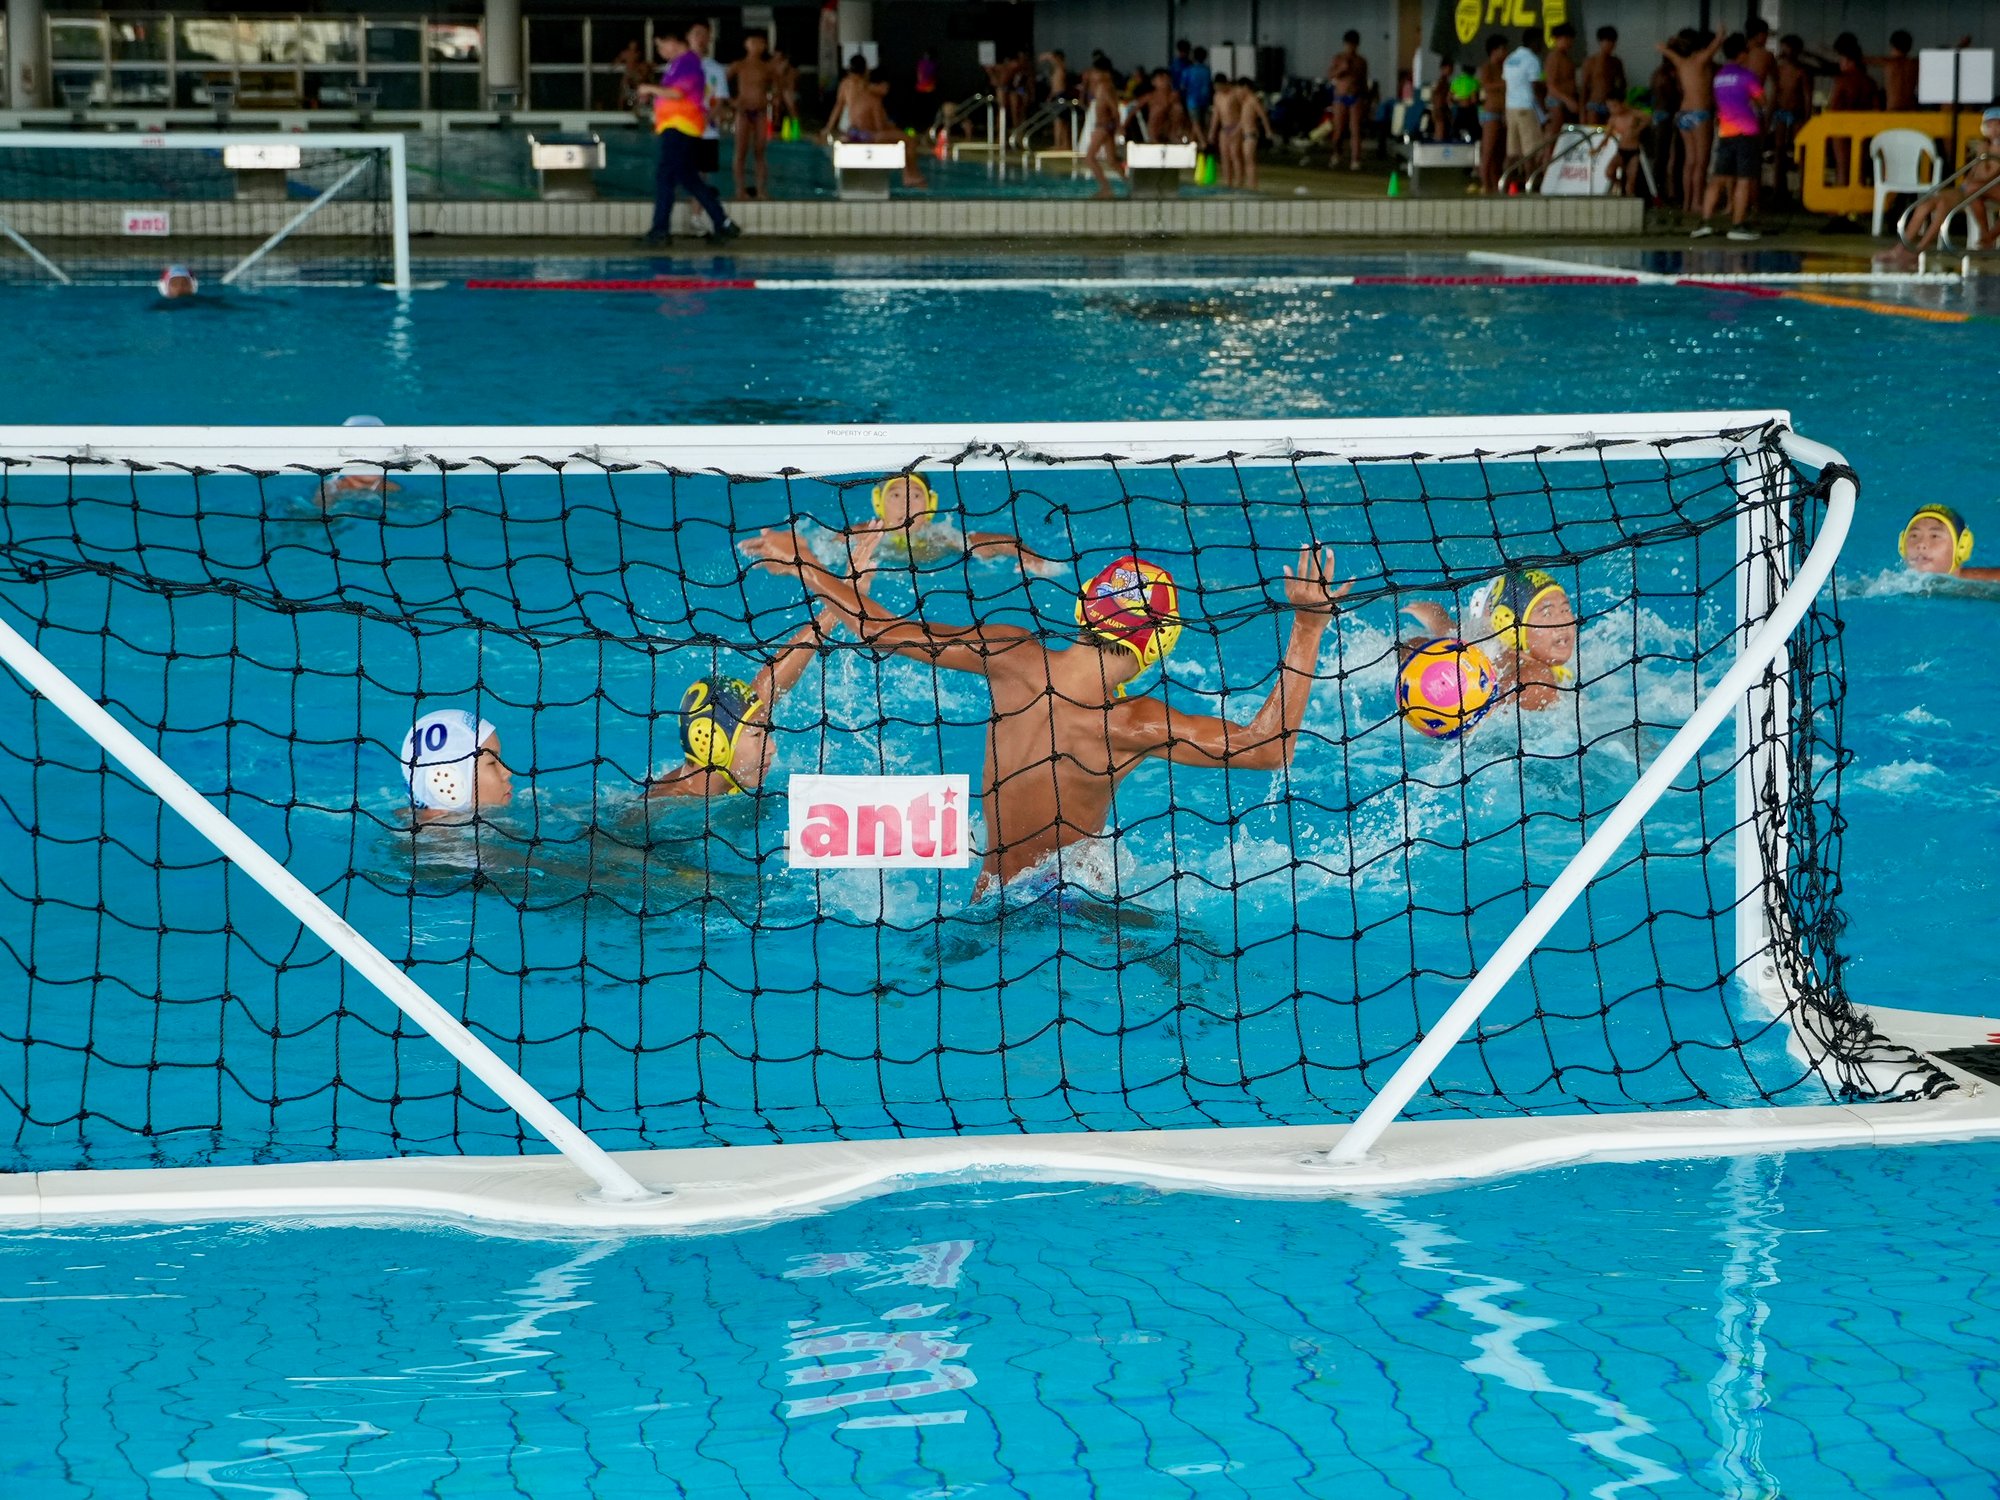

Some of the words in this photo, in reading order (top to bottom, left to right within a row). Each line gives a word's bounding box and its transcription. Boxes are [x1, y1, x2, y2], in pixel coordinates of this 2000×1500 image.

[128, 216, 167, 232] anti
[827, 429, 861, 437] PROPERTY
[688, 682, 713, 718] 2
[410, 723, 448, 758] 10
[801, 786, 958, 858] anti
